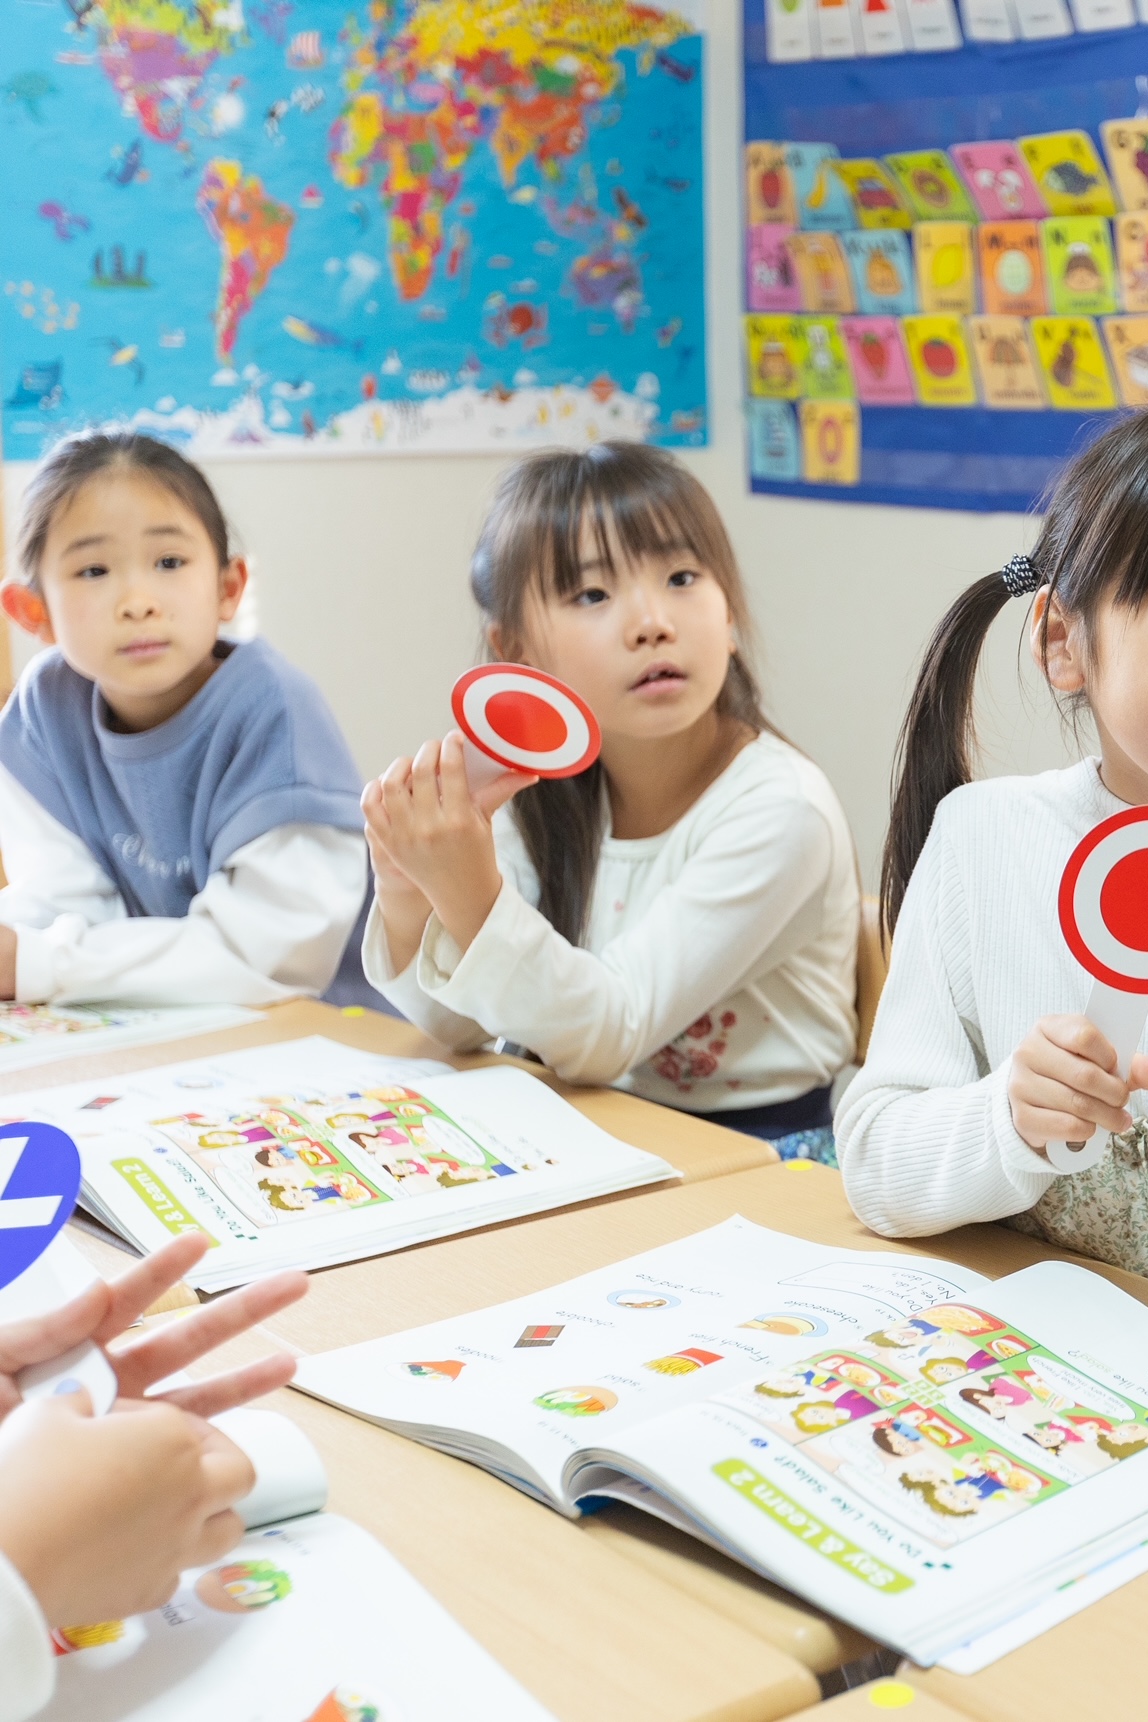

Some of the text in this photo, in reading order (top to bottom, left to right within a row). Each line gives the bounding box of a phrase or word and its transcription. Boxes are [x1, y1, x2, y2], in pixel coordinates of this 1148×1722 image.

[121, 1162, 143, 1174] 2
[134, 1172, 175, 1211] Learn
[635, 1273, 721, 1298] curry and rice
[884, 1288, 909, 1301] you
[783, 1300, 858, 1324] cheesecake
[908, 1299, 923, 1312] Do
[555, 1310, 613, 1328] chocolate
[454, 1345, 501, 1362] noodles
[688, 1332, 771, 1362] French fries
[1067, 1349, 1114, 1374] salad?
[596, 1373, 641, 1388] salad
[1112, 1373, 1135, 1390] like
[728, 1468, 755, 1486] 2
[752, 1482, 823, 1541] Learn
[773, 1454, 923, 1559] Do You Like Salad?
[818, 1535, 845, 1555] &
[843, 1550, 896, 1587] Say
